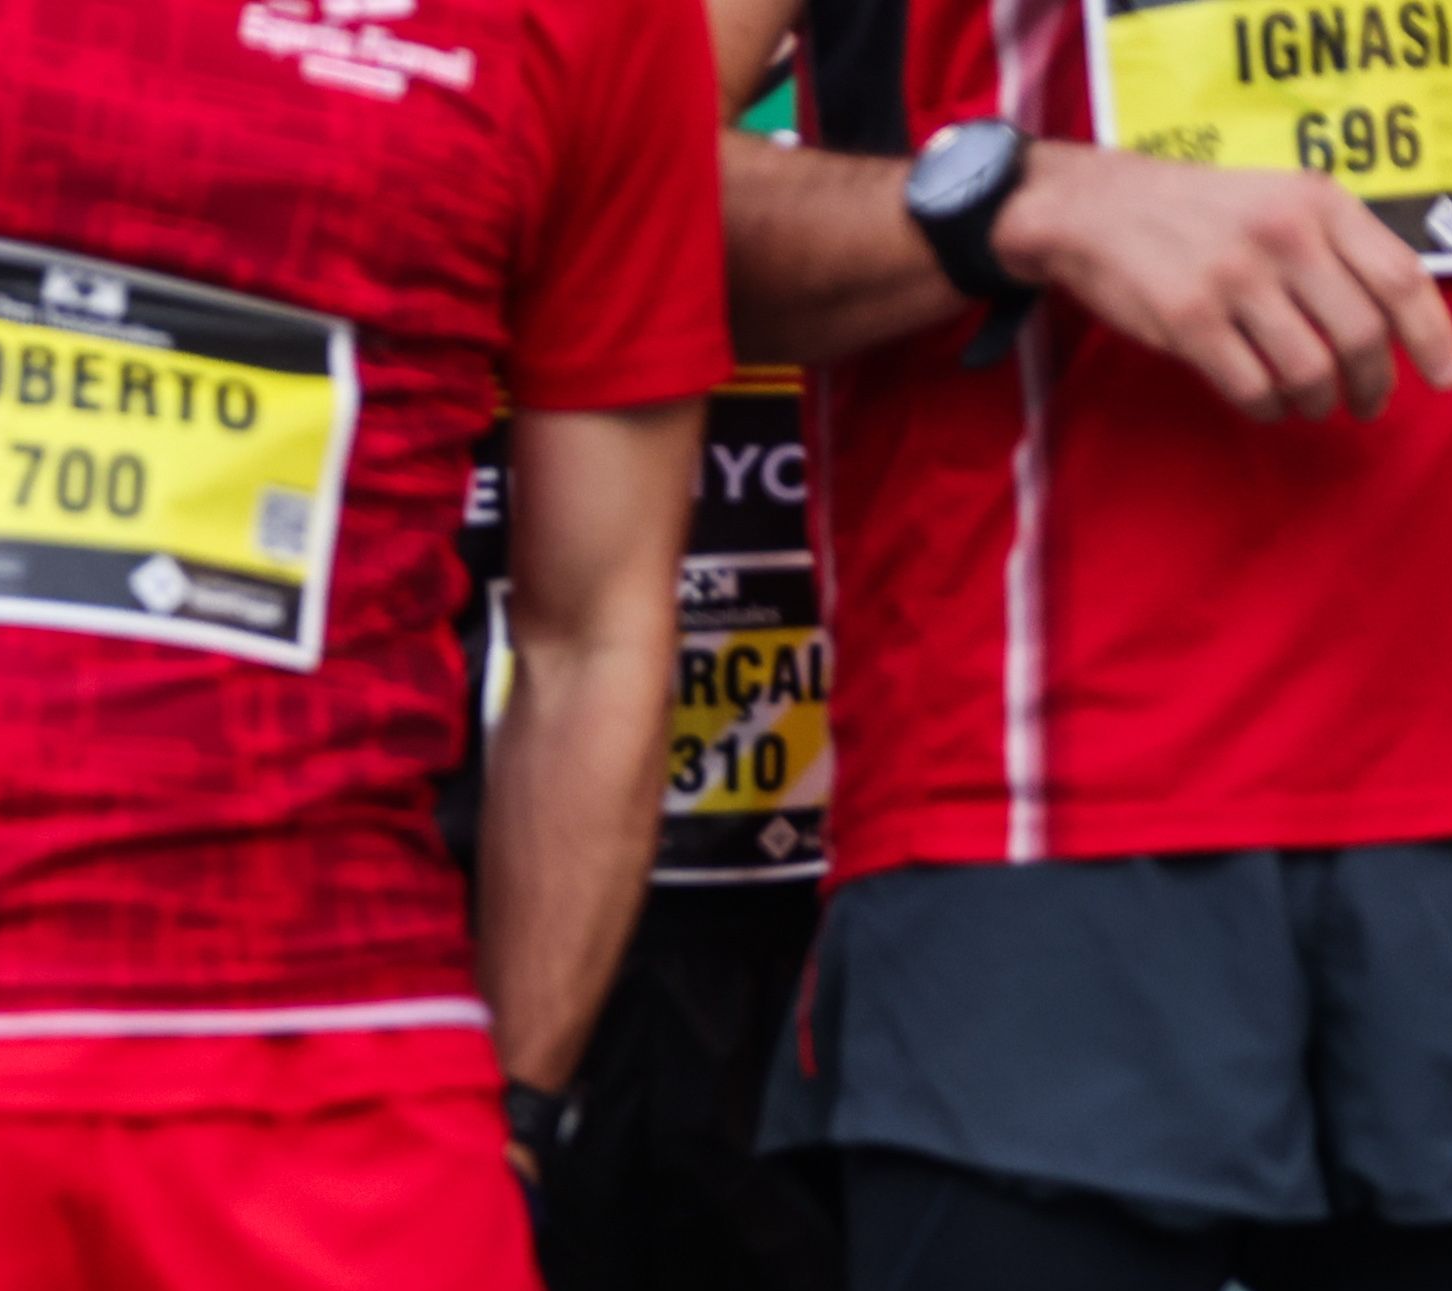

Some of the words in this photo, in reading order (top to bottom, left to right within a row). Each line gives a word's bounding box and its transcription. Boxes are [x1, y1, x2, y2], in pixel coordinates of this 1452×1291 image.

[1296, 103, 1421, 172] 696
[4, 438, 149, 528] 700
[671, 730, 787, 794] 310
